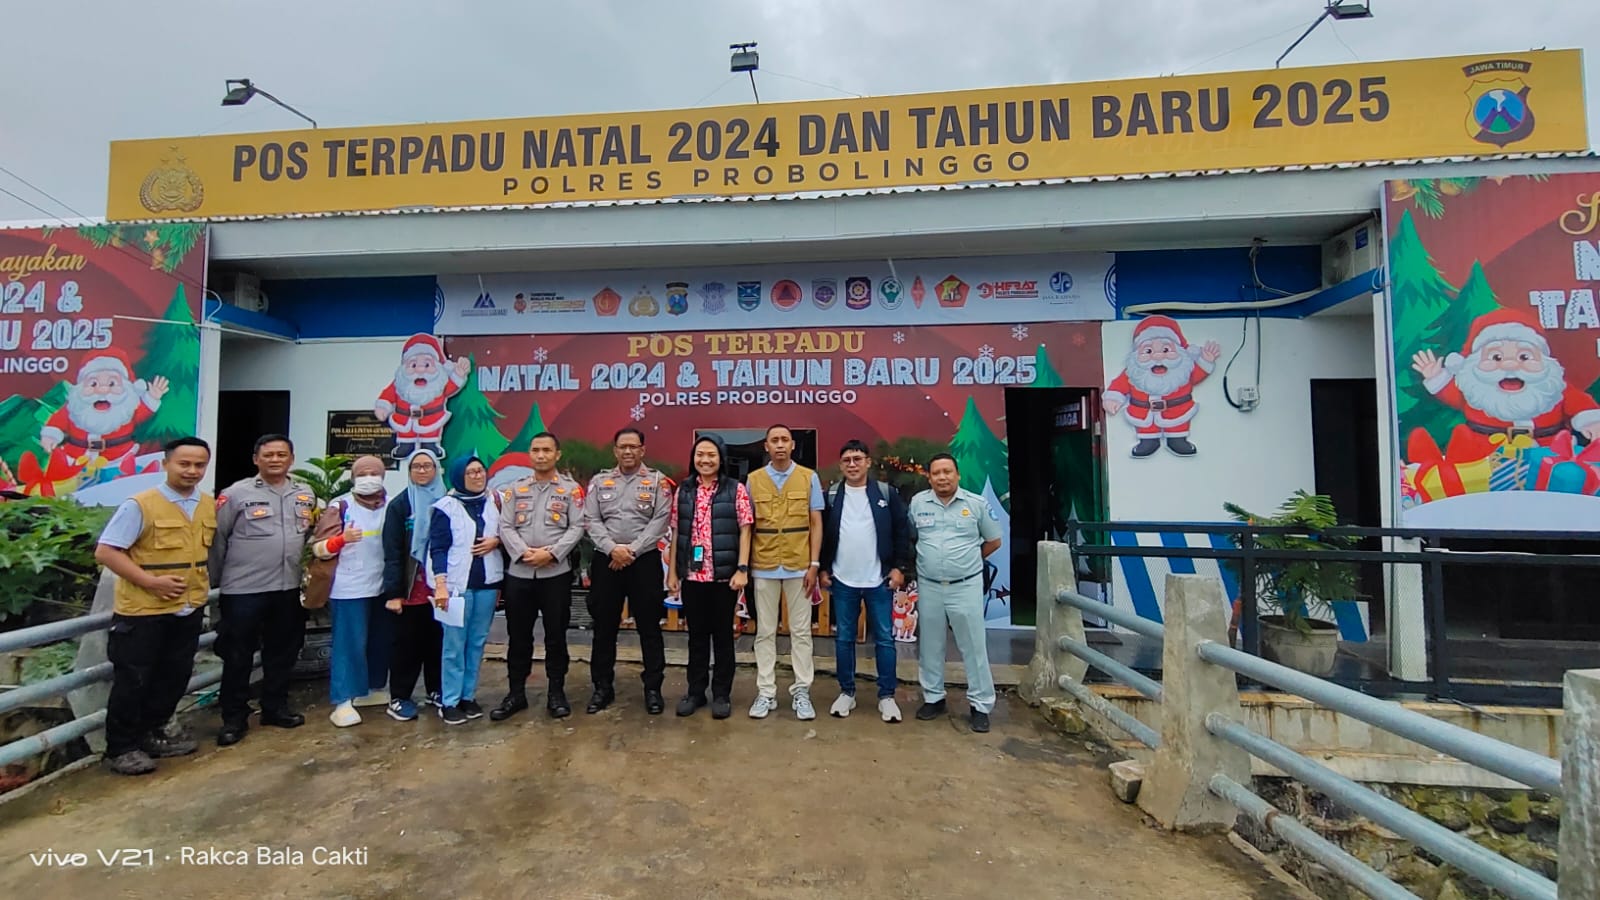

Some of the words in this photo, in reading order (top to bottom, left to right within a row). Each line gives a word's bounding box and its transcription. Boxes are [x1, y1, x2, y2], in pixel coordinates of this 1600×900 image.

[1469, 64, 1494, 74] JAWA
[1496, 62, 1524, 70] TIMUR
[233, 143, 308, 182] POS
[323, 131, 504, 178] TERPADU
[522, 124, 651, 170] NATAL
[668, 117, 780, 163] 2024
[799, 110, 891, 156] DAN
[908, 98, 1069, 149] TAHUN
[1092, 87, 1230, 139] BARU
[1252, 76, 1390, 129] 2025
[503, 170, 662, 197] POLRES
[693, 151, 1030, 189] PROBOLINGGO
[1559, 191, 1600, 235] S
[0, 280, 46, 314] 24
[57, 280, 83, 313] &
[32, 318, 114, 350] 2025
[627, 335, 694, 358] POS
[704, 330, 865, 356] TERPADU
[478, 363, 580, 392] NATAL
[590, 361, 666, 391] 2024
[676, 360, 700, 388] &
[712, 358, 831, 388] TAHUN
[843, 357, 940, 386] BARU
[952, 355, 1037, 385] 2025
[639, 392, 711, 406] POLRES
[716, 389, 857, 405] PROBOLINGGO
